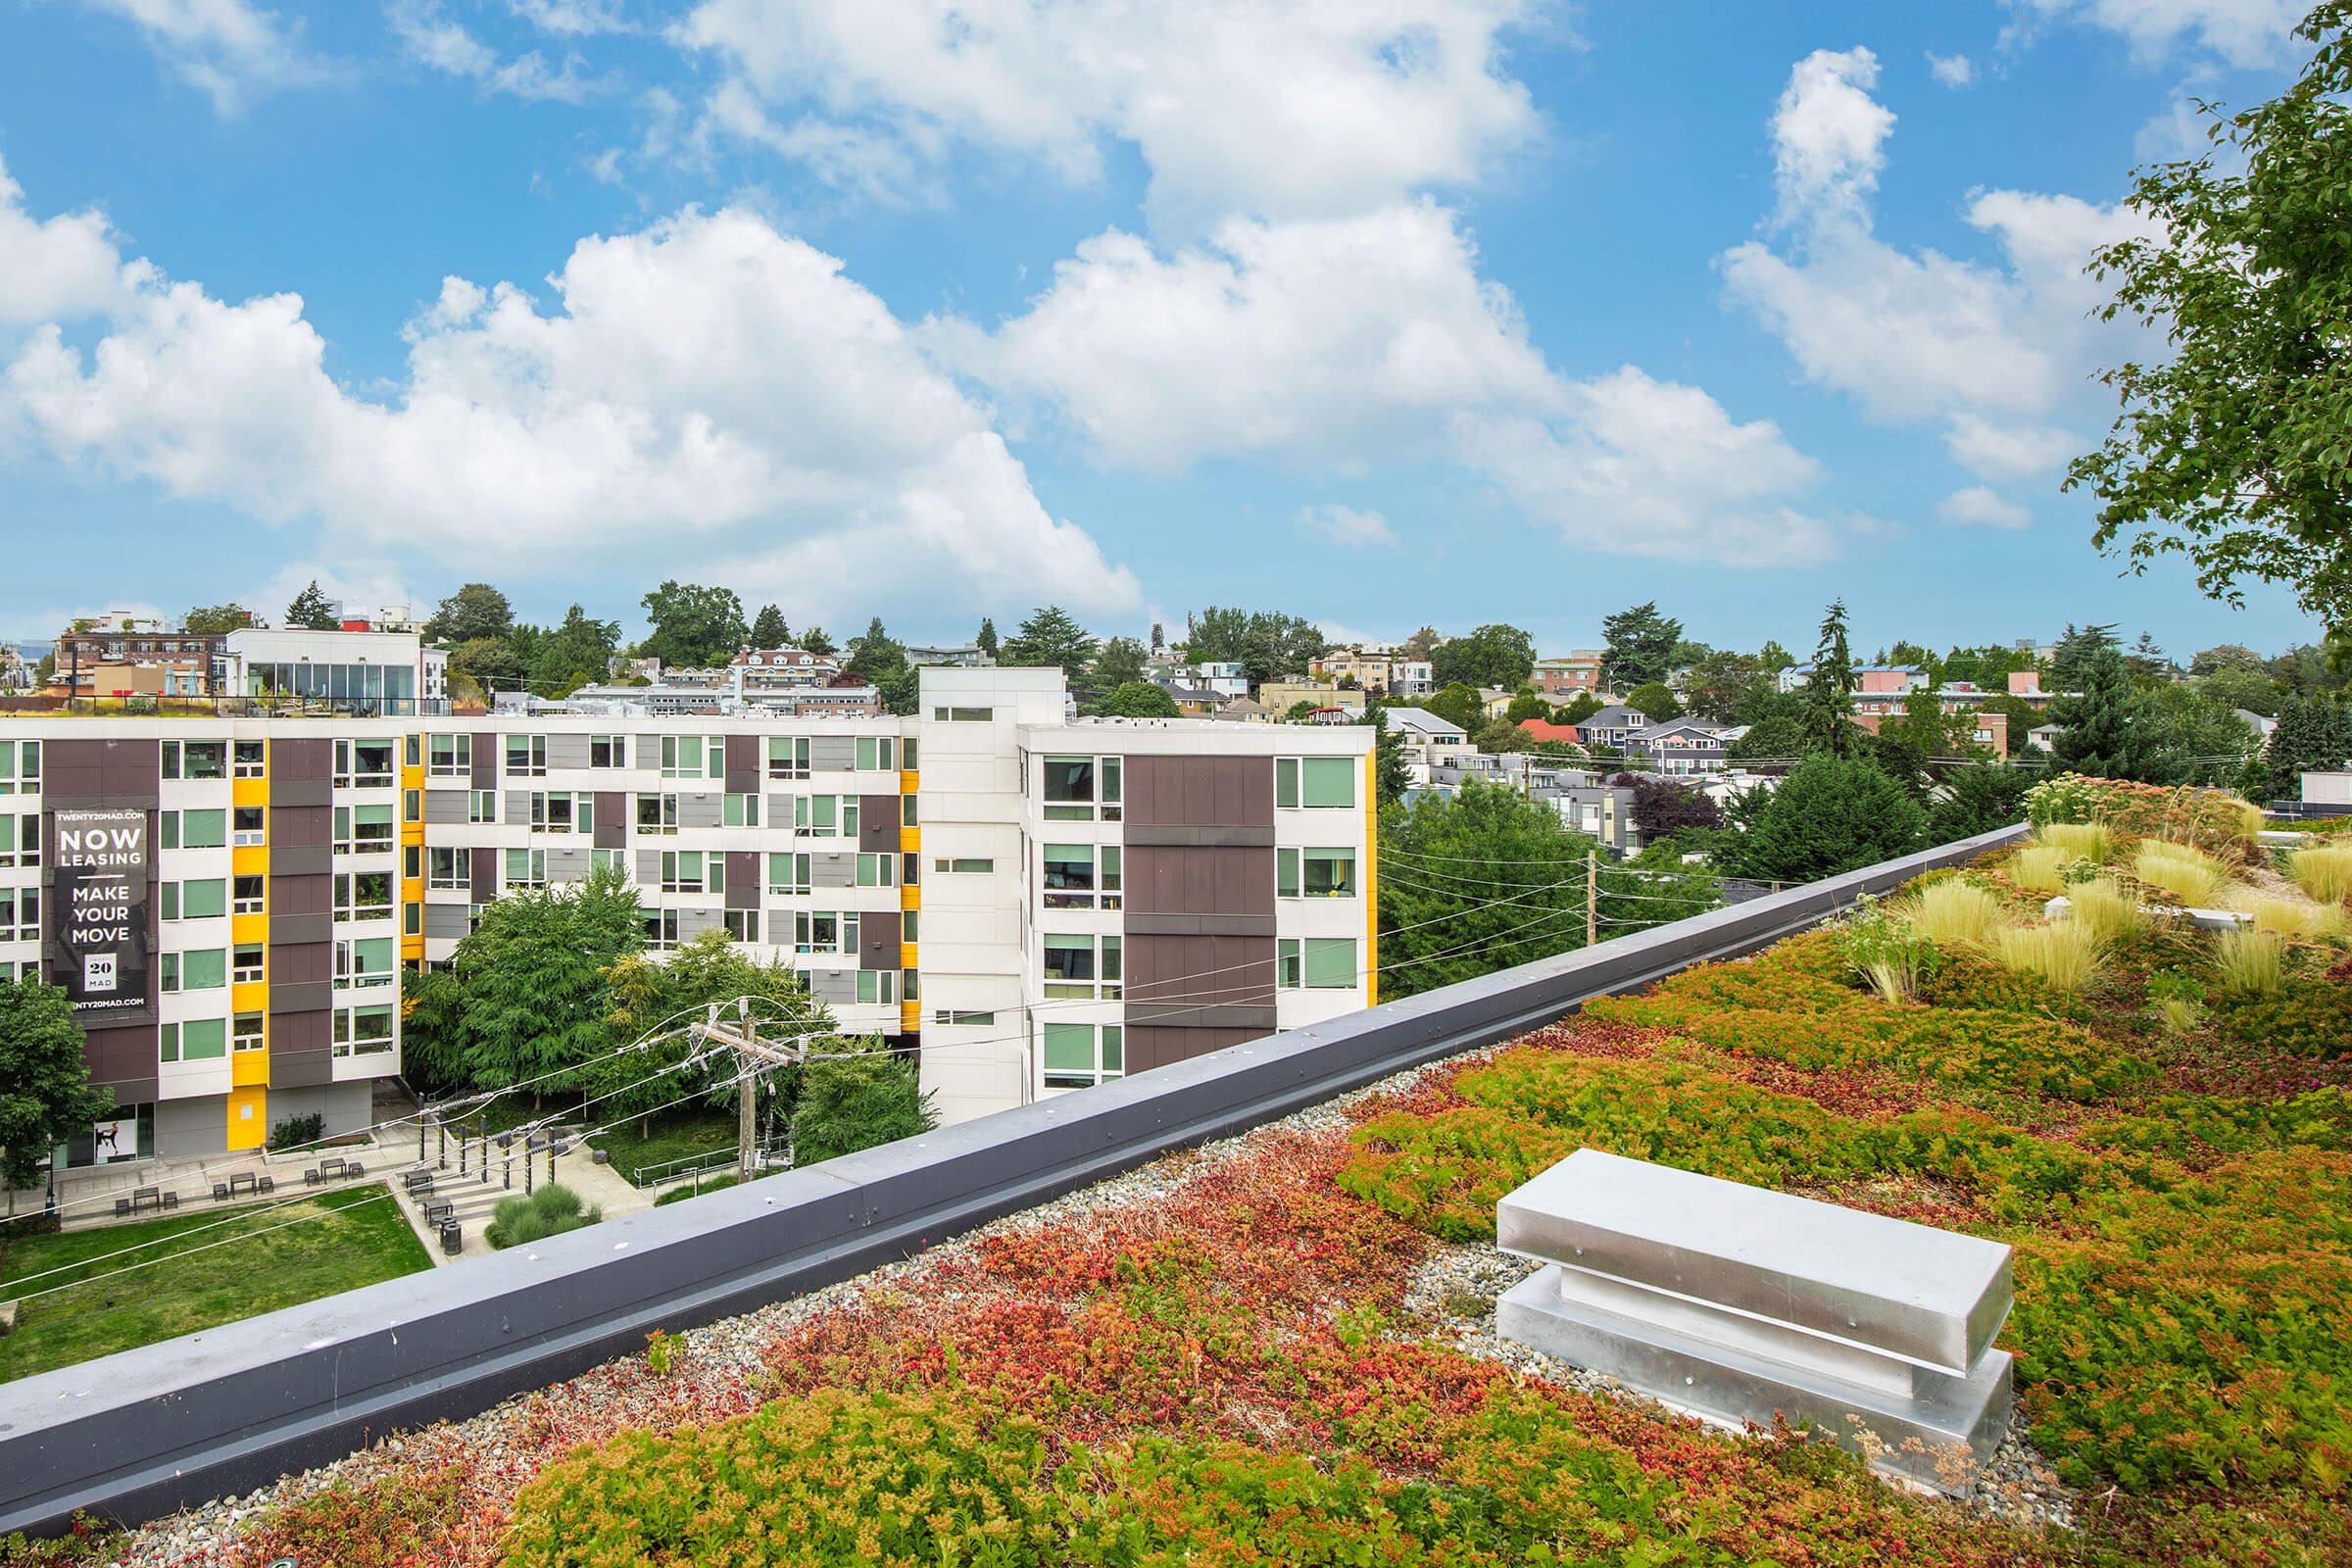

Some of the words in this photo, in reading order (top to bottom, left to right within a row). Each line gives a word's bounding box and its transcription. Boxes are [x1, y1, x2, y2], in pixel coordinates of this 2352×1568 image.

[58, 812, 144, 821] TWENTY20MAD.COM
[61, 828, 141, 851] NOW
[61, 852, 141, 867] LEASING
[73, 886, 129, 902] MAKE
[74, 906, 128, 922] YOUR
[73, 927, 129, 944] MOVE
[89, 962, 112, 974] 20
[73, 998, 144, 1009] NTY20MAD.COM
